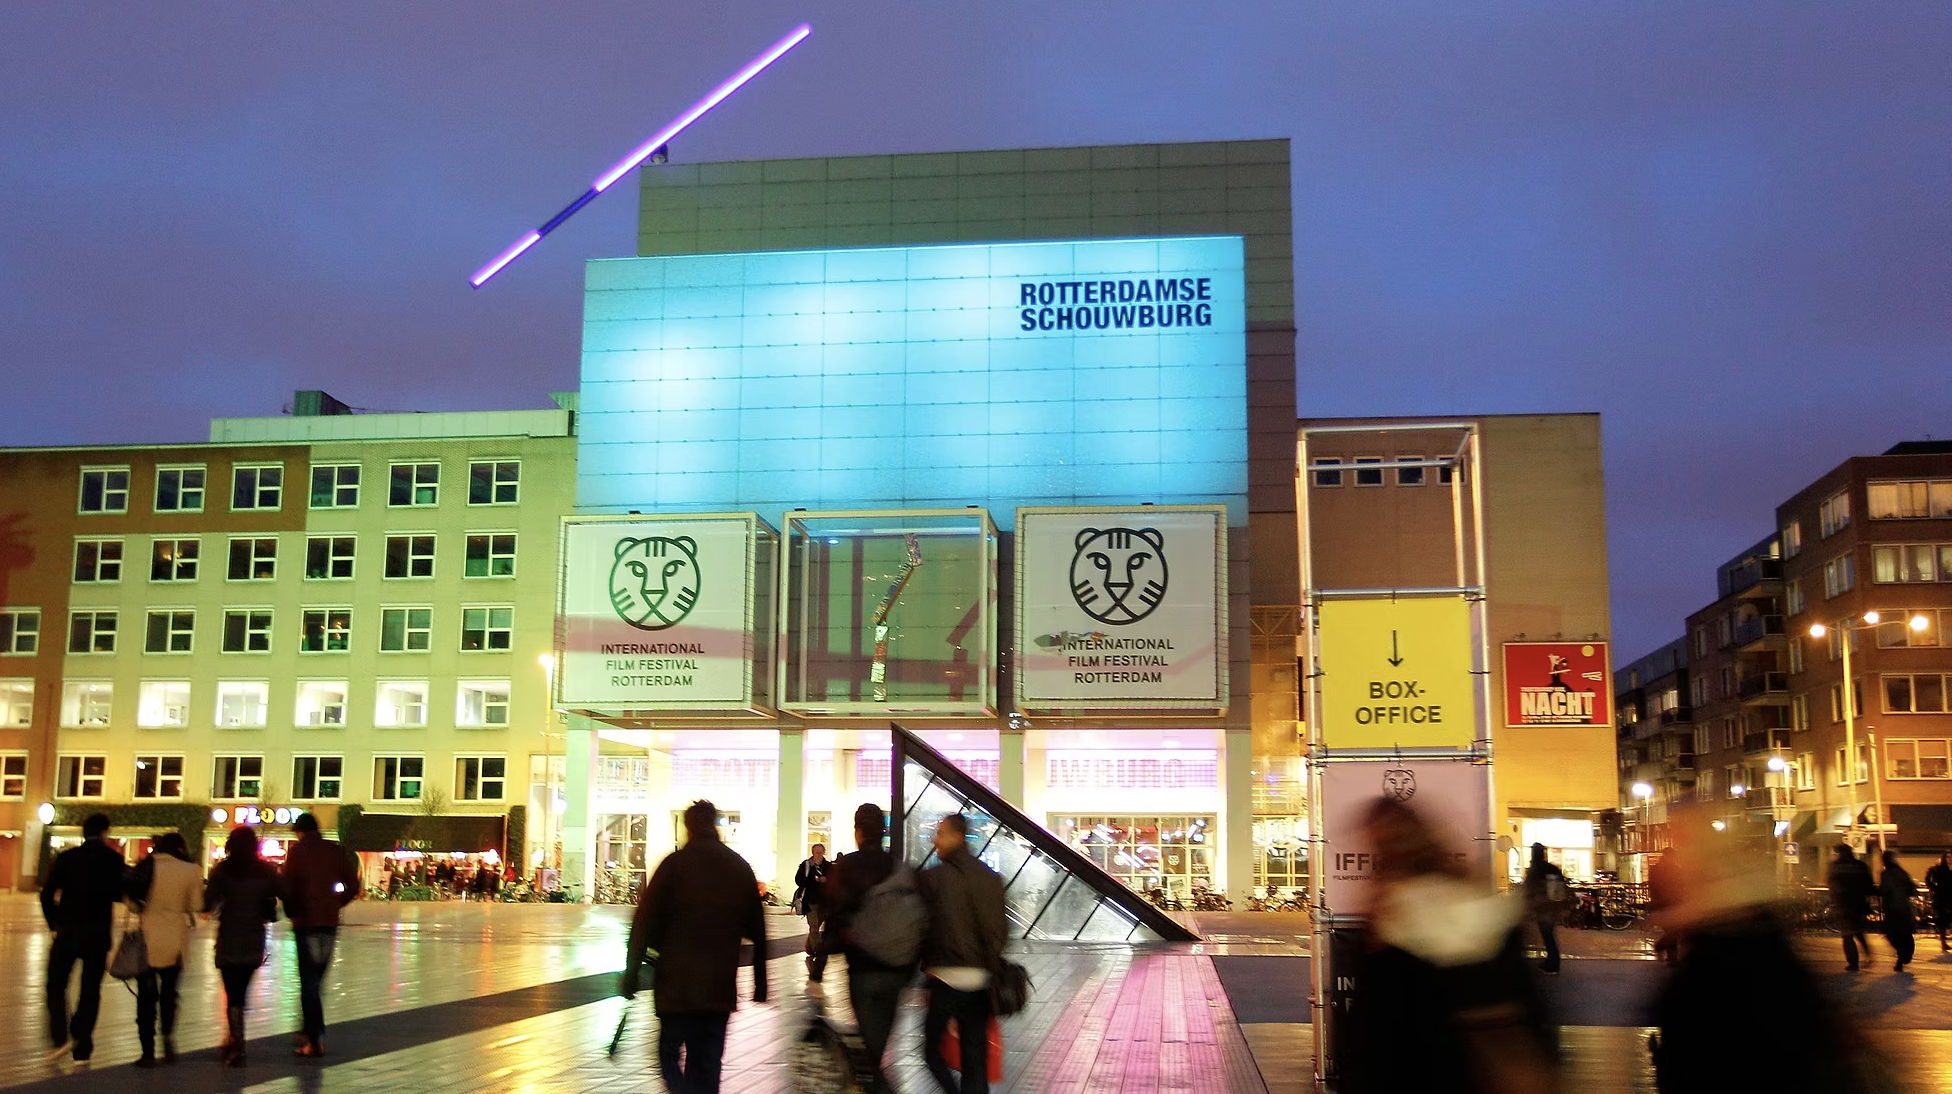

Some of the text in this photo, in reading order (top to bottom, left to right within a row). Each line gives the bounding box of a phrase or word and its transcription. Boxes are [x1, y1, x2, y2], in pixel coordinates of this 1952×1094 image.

[1020, 277, 1211, 306] ROTTERDAMSE
[1020, 303, 1212, 331] SCHOUWBURG
[601, 643, 705, 655] INTERNATIONAL
[606, 659, 699, 671] FILM FESTIVAL
[1069, 654, 1168, 667] FILM FESTIVAL
[611, 675, 693, 687] ROTTERDAM
[1075, 672, 1162, 684] ROTTERDAM
[1369, 680, 1426, 699] BOX-
[1520, 691, 1596, 716] NACHT
[1355, 705, 1442, 725] OFFICE
